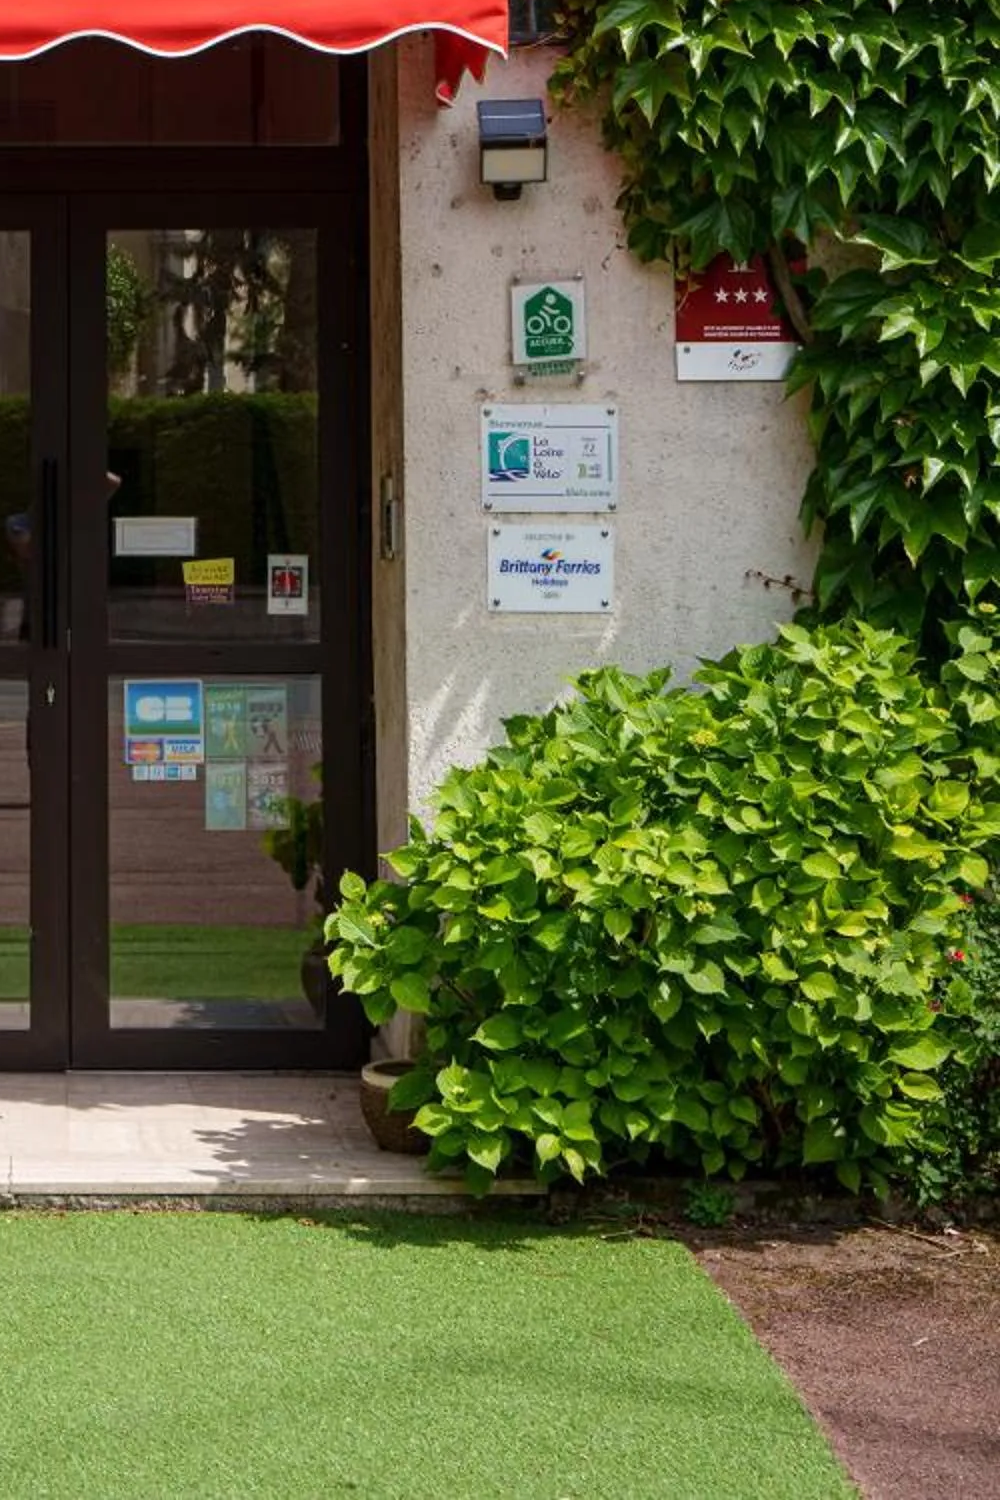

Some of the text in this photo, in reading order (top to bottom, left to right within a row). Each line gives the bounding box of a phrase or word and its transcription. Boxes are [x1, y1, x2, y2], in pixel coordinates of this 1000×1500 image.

[533, 436, 549, 447] La
[533, 447, 565, 457] Loire
[500, 559, 601, 576] Brittany Ferries
